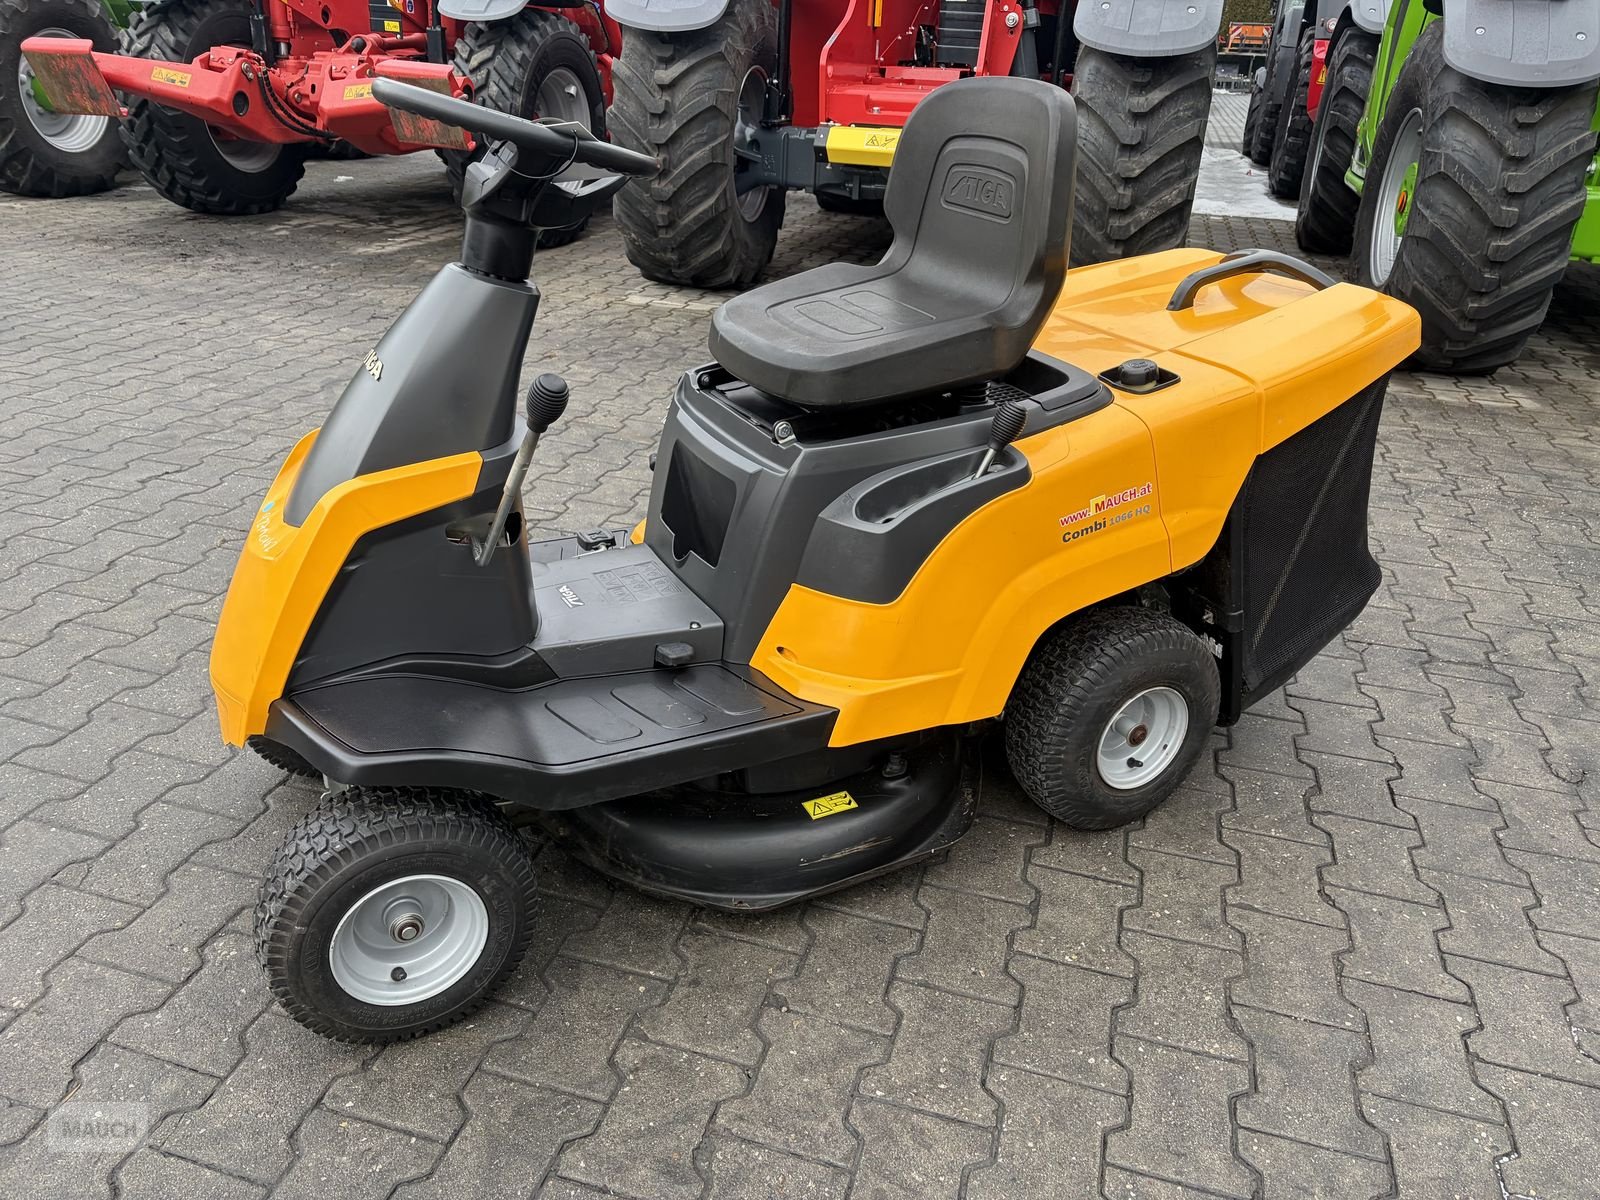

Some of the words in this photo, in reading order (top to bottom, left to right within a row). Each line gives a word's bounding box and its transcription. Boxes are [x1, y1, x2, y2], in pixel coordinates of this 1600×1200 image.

[951, 175, 1006, 210] STIGA
[1062, 517, 1107, 543] Combi
[1109, 511, 1133, 526] 1066
[1135, 504, 1151, 516] HQ
[559, 585, 585, 608] STIGA
